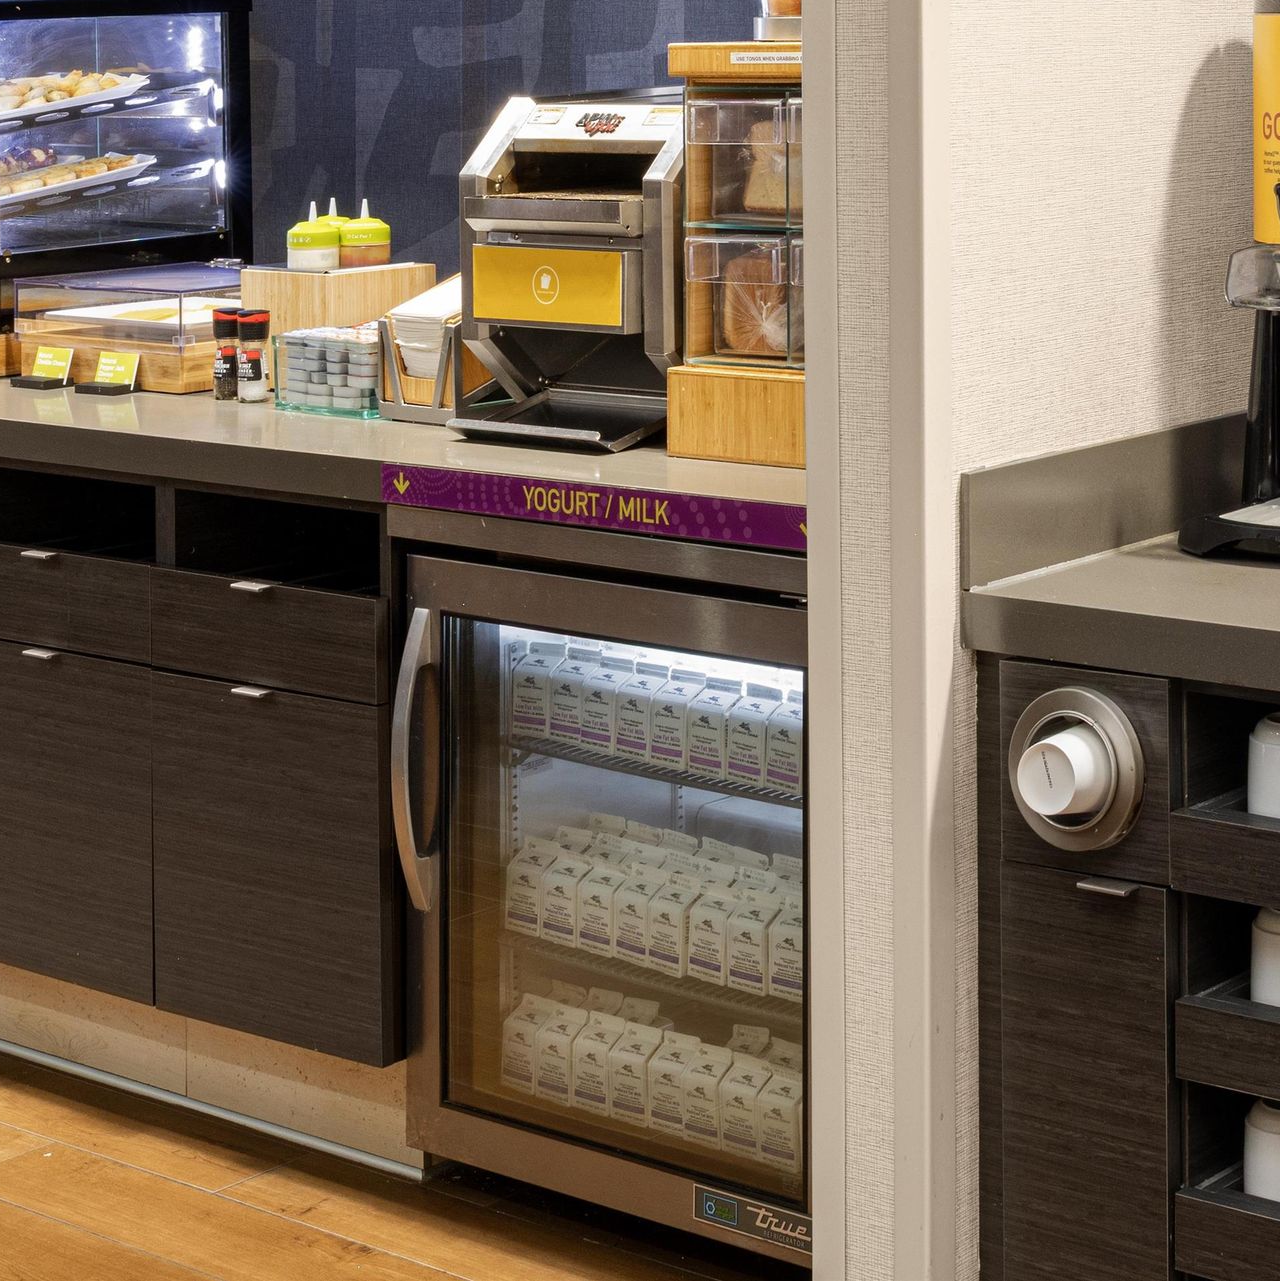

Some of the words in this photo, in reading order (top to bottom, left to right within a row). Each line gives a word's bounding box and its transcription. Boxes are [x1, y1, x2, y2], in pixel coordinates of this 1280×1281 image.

[523, 486, 600, 517] YOGURT
[605, 495, 613, 518] /
[619, 496, 670, 526] MILK
[746, 1208, 811, 1241] true
[764, 1230, 805, 1248] REFRIGERATOR
